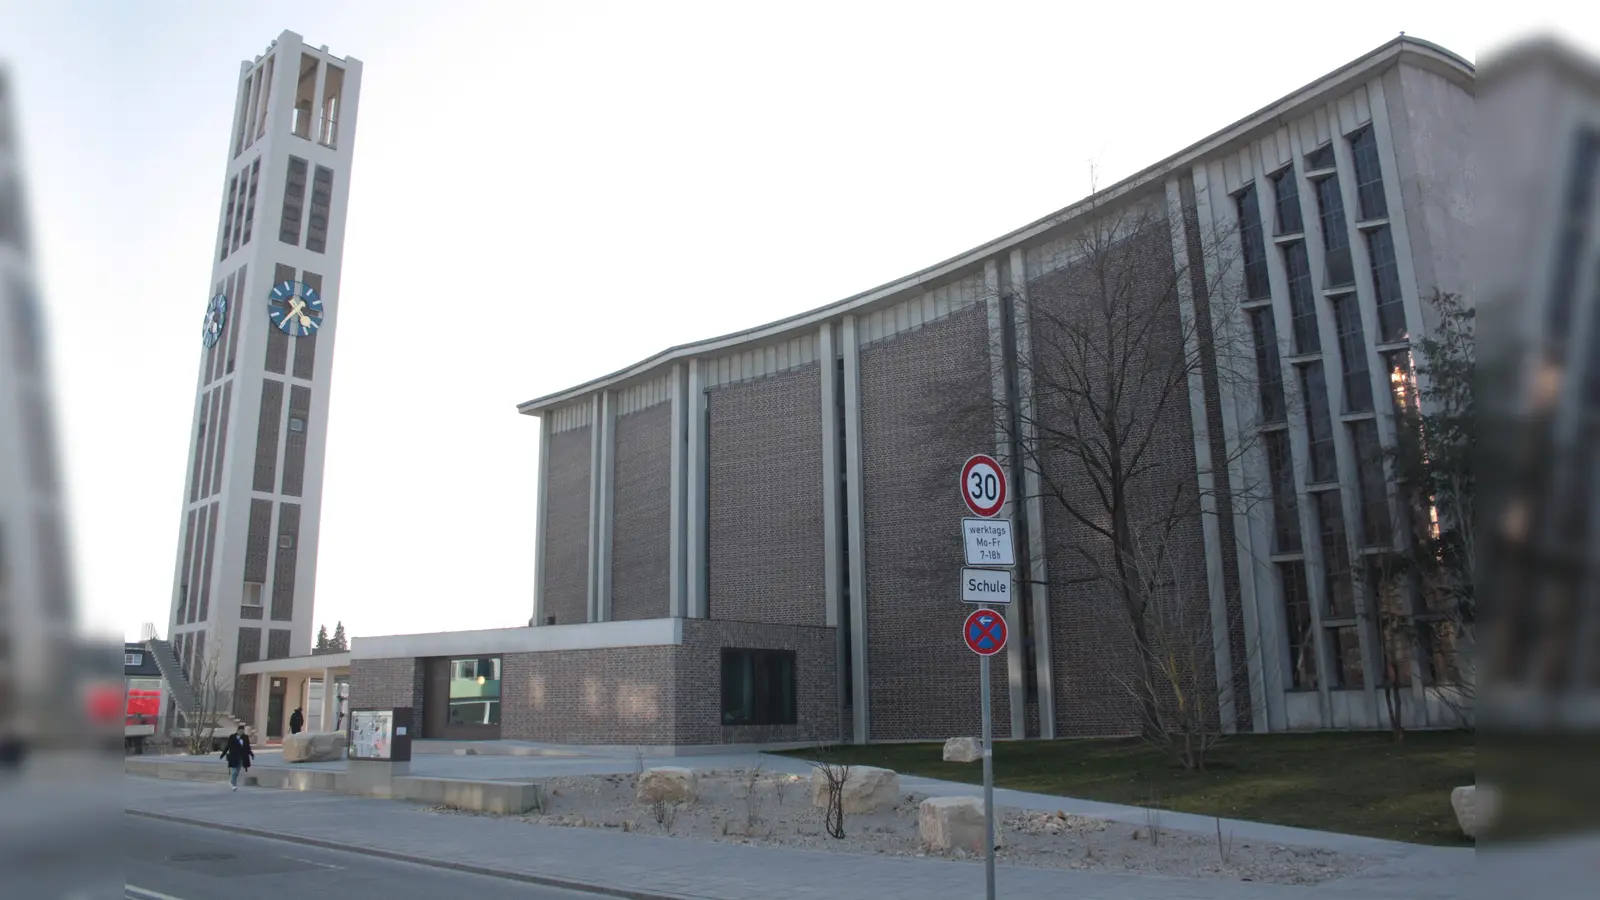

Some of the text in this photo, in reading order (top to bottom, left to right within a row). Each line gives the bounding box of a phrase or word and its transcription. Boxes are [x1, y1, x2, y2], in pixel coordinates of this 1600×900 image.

[971, 472, 997, 501] 30
[969, 525, 1006, 537] werktags
[976, 537, 1001, 547] Mo-Fr
[979, 550, 1001, 560] 7-18h
[968, 579, 1007, 593] Schule
